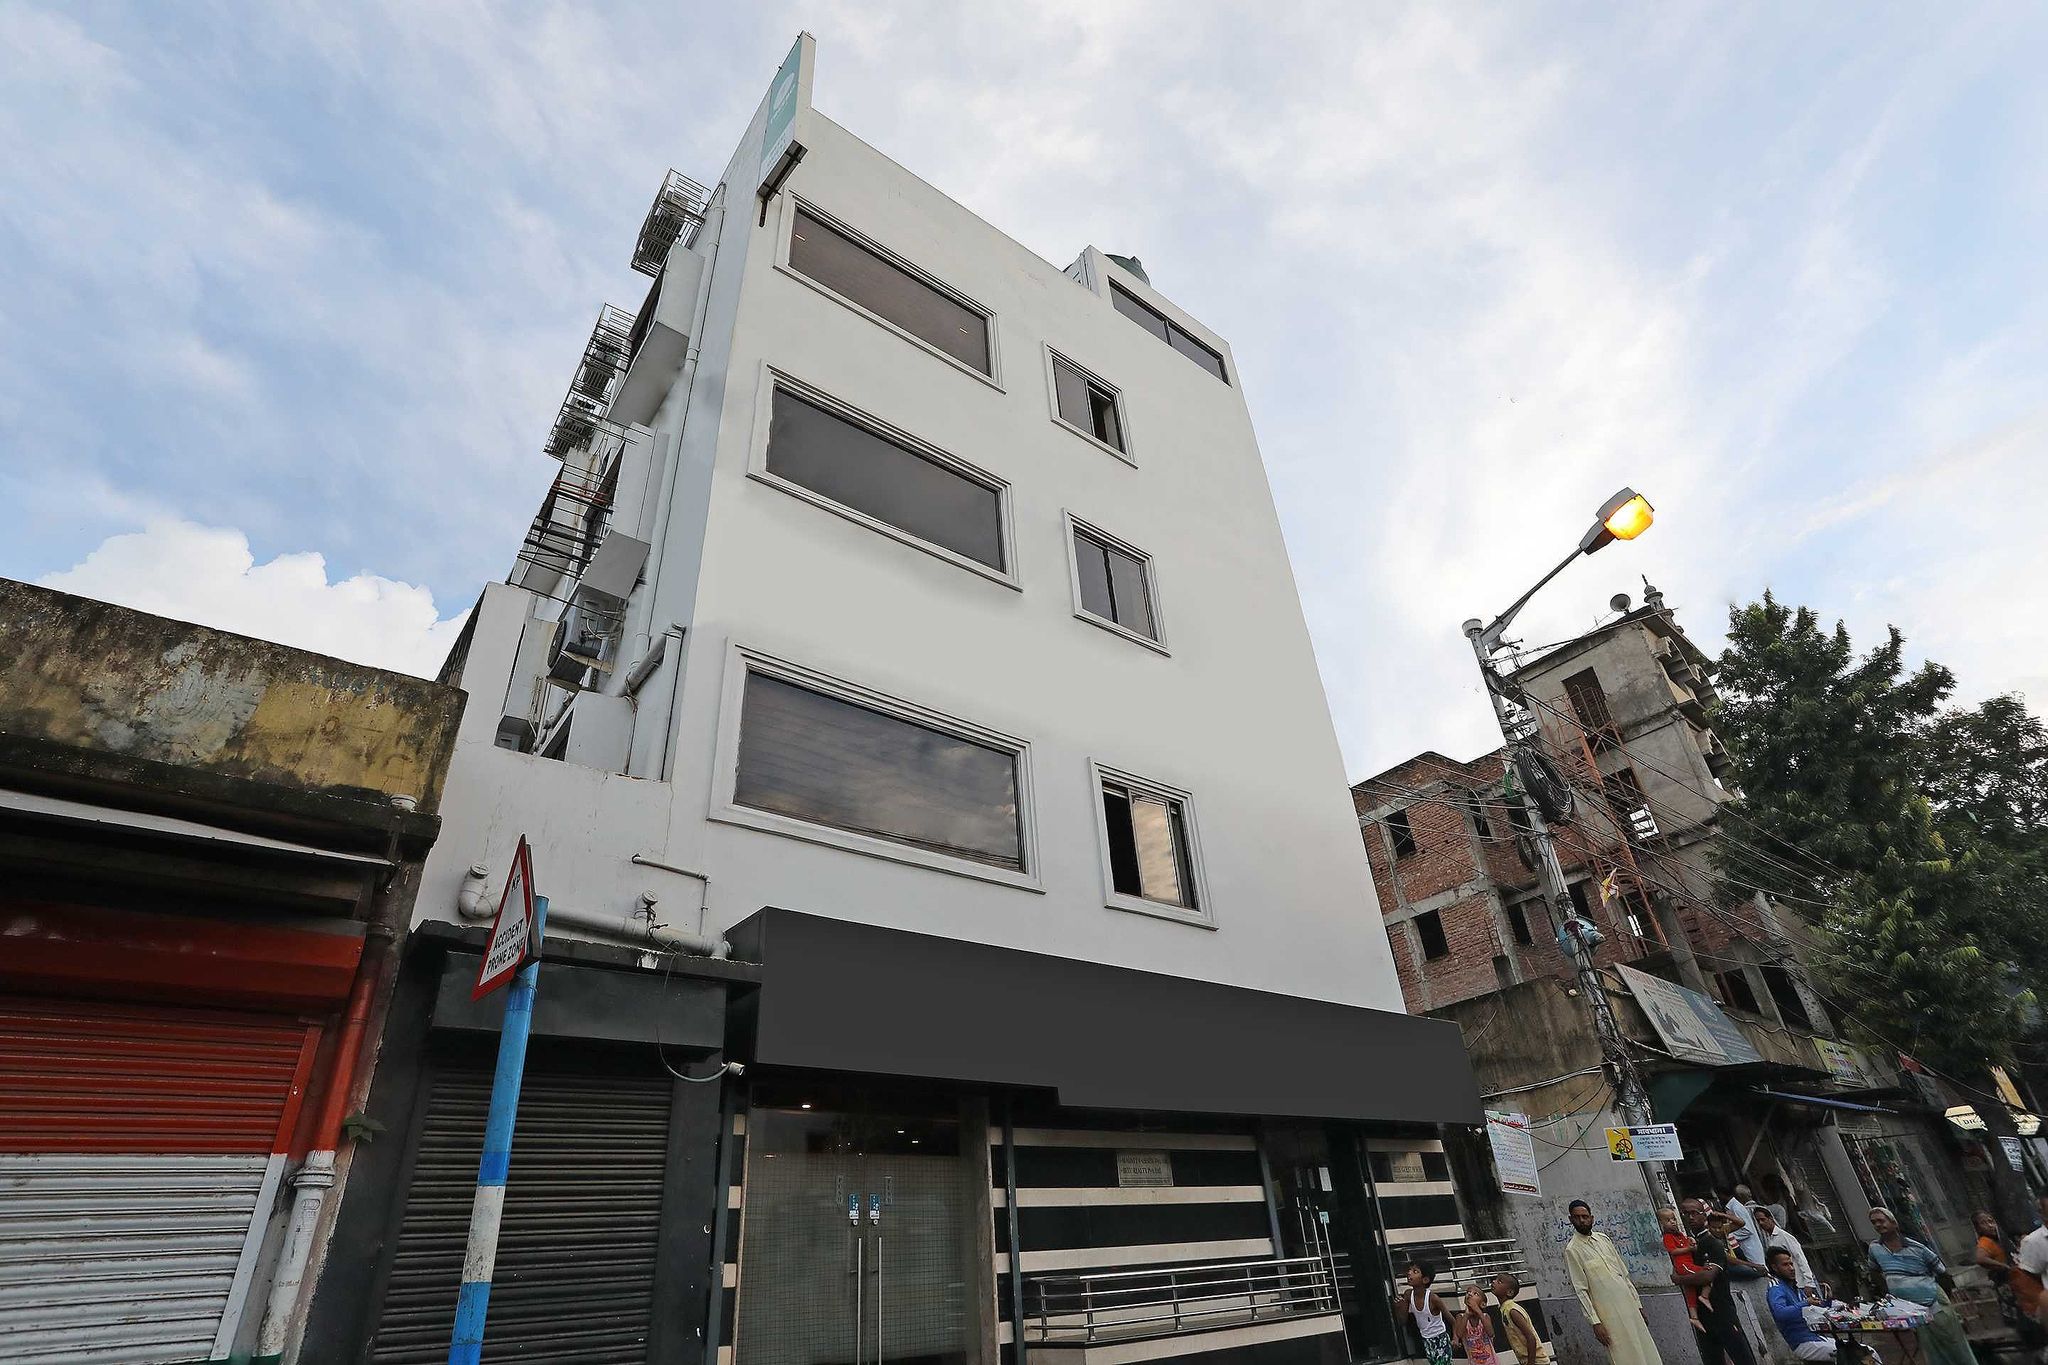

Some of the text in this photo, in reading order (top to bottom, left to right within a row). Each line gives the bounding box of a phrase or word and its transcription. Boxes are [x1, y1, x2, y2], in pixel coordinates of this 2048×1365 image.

[493, 918, 524, 952] ACCIDENT
[486, 936, 525, 975] PRONE ZONE
